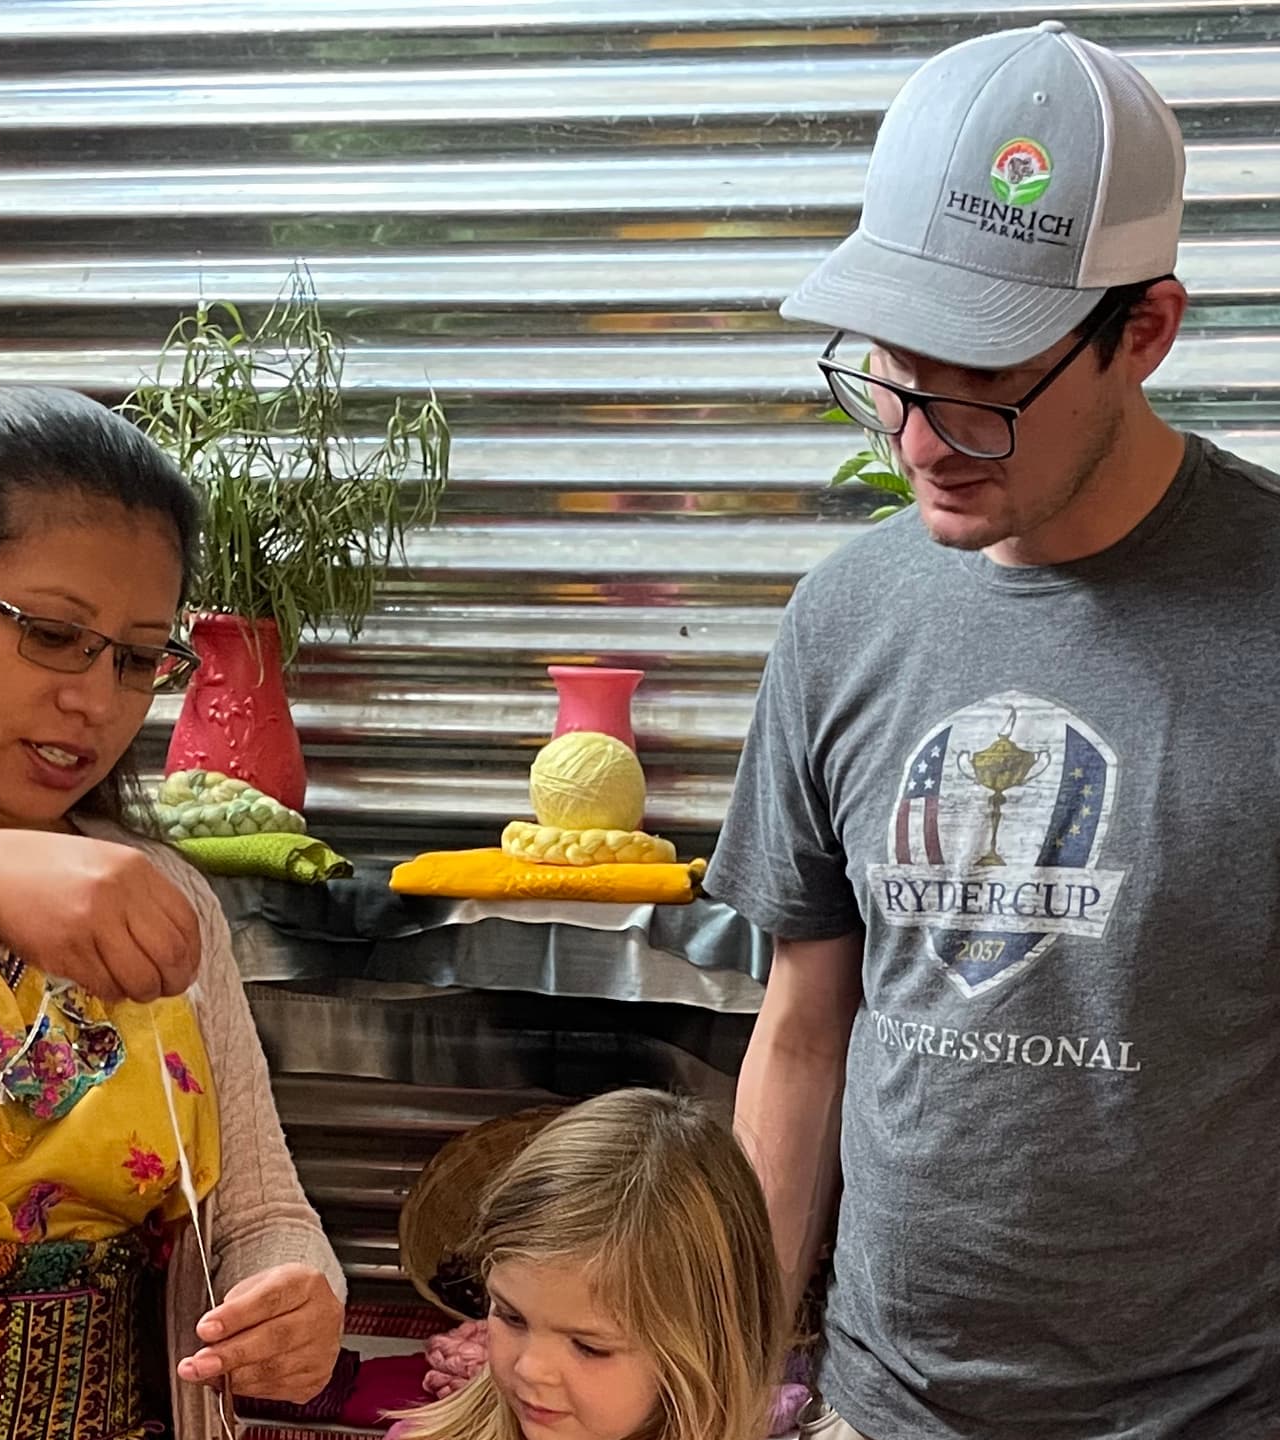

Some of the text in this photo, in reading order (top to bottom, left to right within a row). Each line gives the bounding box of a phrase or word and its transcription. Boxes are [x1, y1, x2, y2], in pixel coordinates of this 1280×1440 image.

[946, 190, 1074, 237] HEINRICH
[979, 221, 1035, 244] FARMS
[954, 940, 1006, 961] 2037
